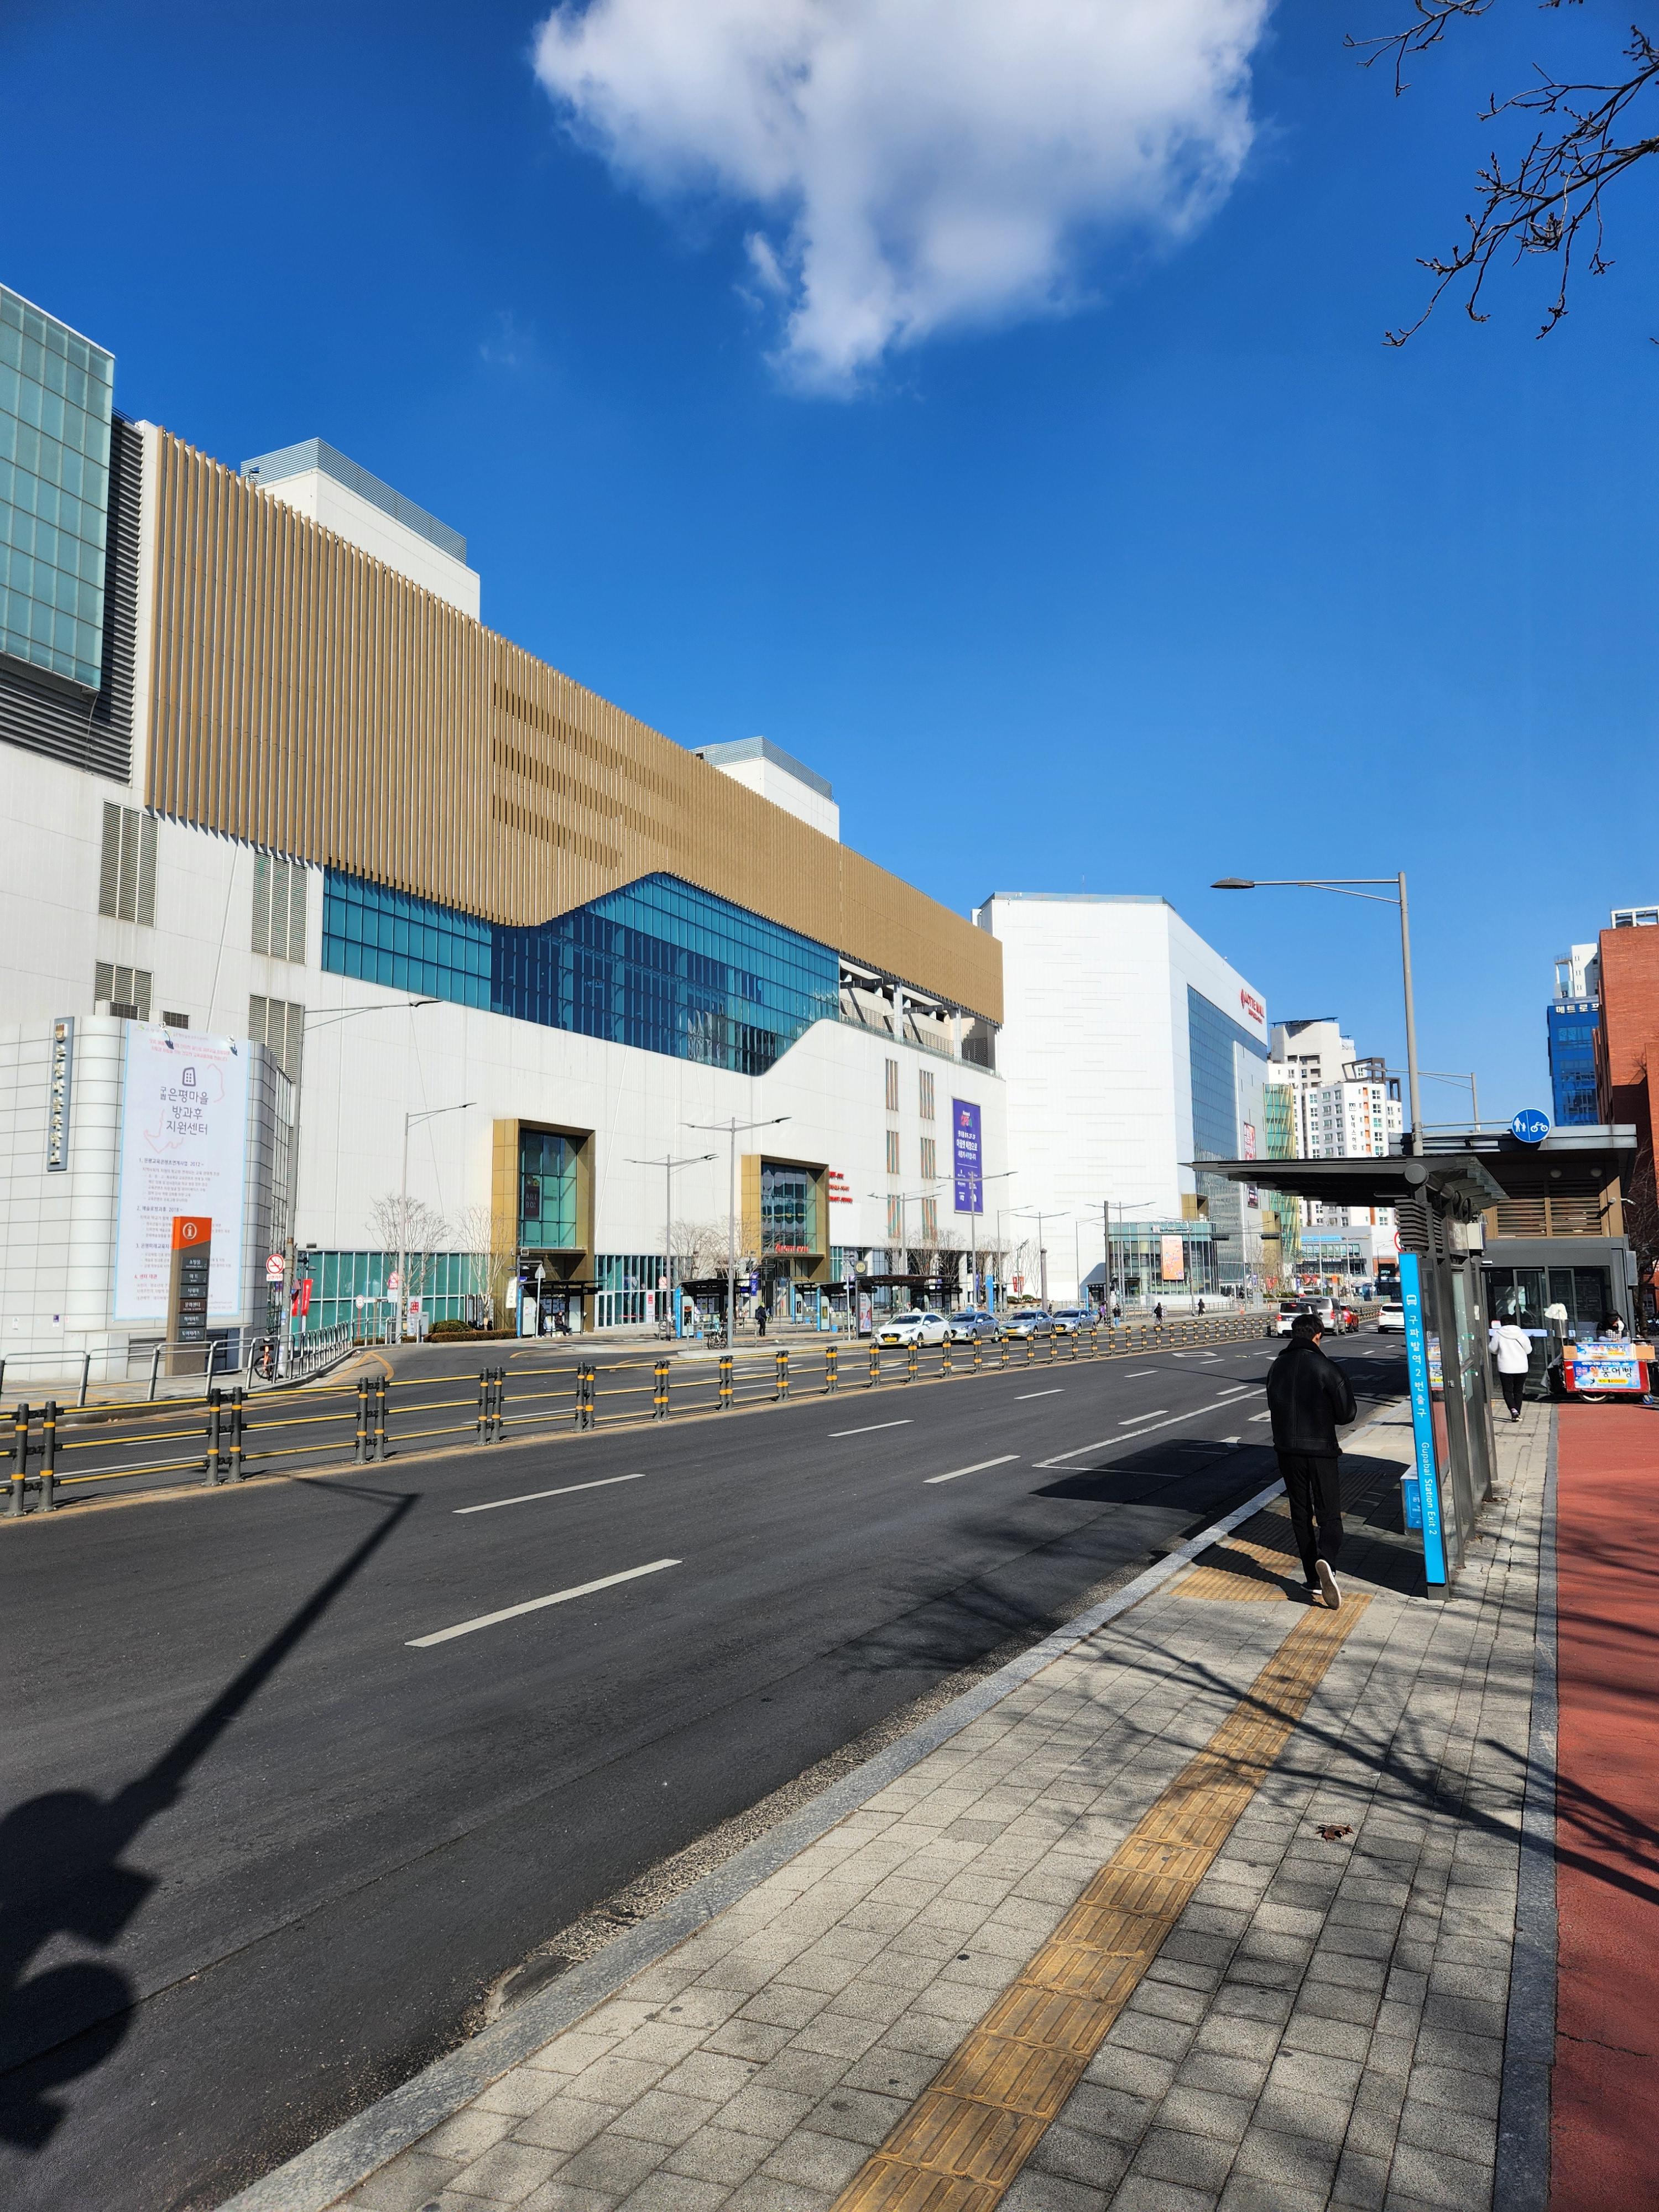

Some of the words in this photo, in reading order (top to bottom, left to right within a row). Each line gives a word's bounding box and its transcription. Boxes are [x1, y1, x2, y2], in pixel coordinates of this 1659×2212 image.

[168, 1088, 208, 1105] 은평마을
[172, 1105, 203, 1120] 방과후
[166, 1120, 208, 1135] 지원센터
[1421, 1442, 1431, 1476] Gupabal
[1425, 1479, 1433, 1509] Station
[1427, 1511, 1436, 1527] Exit
